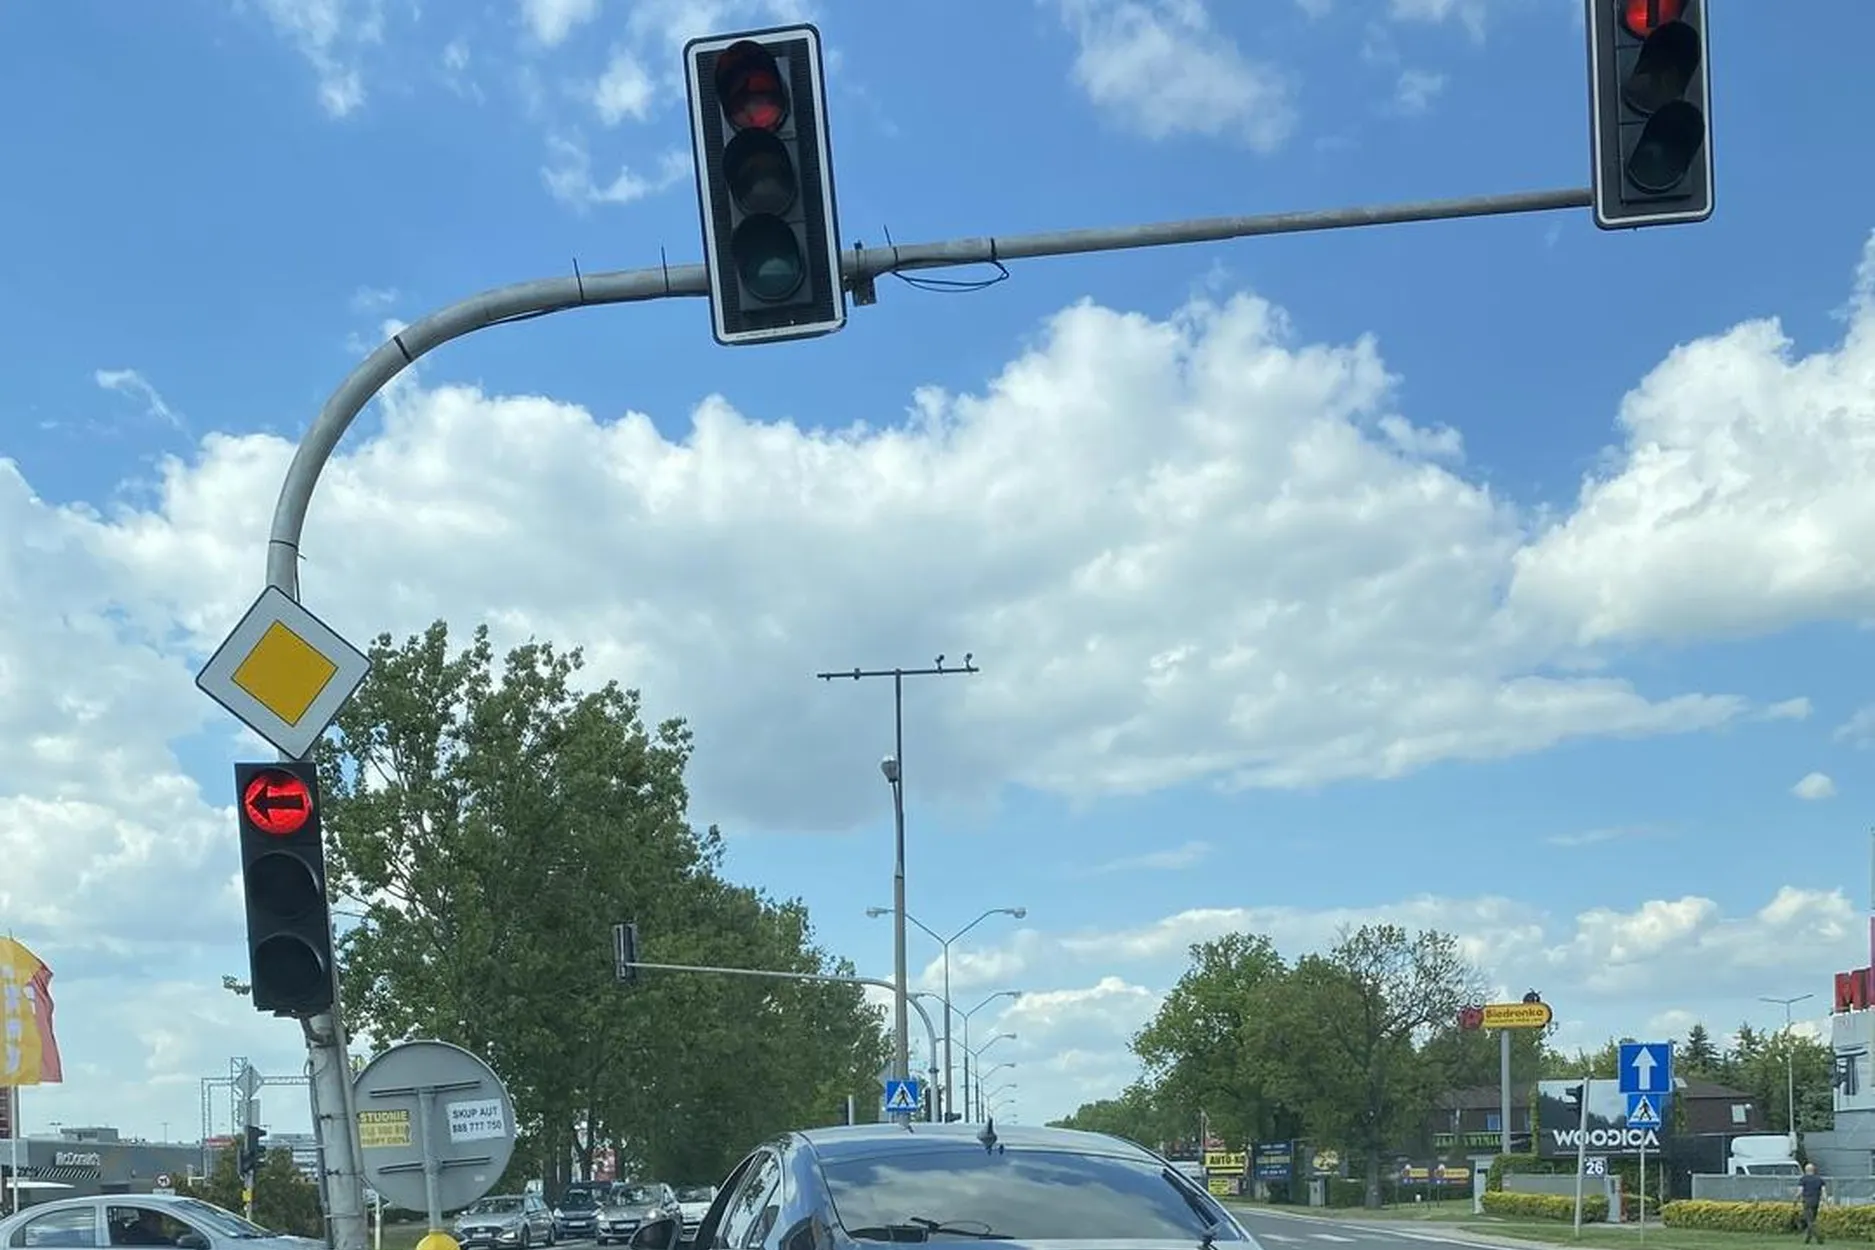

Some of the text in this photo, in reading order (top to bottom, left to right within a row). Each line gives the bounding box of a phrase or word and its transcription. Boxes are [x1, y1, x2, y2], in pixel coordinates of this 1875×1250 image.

[1485, 1007, 1544, 1018] Biedronka
[359, 1110, 407, 1123] STUDNIE
[452, 1105, 497, 1119] SKUP AUT
[1586, 1161, 1604, 1175] 26
